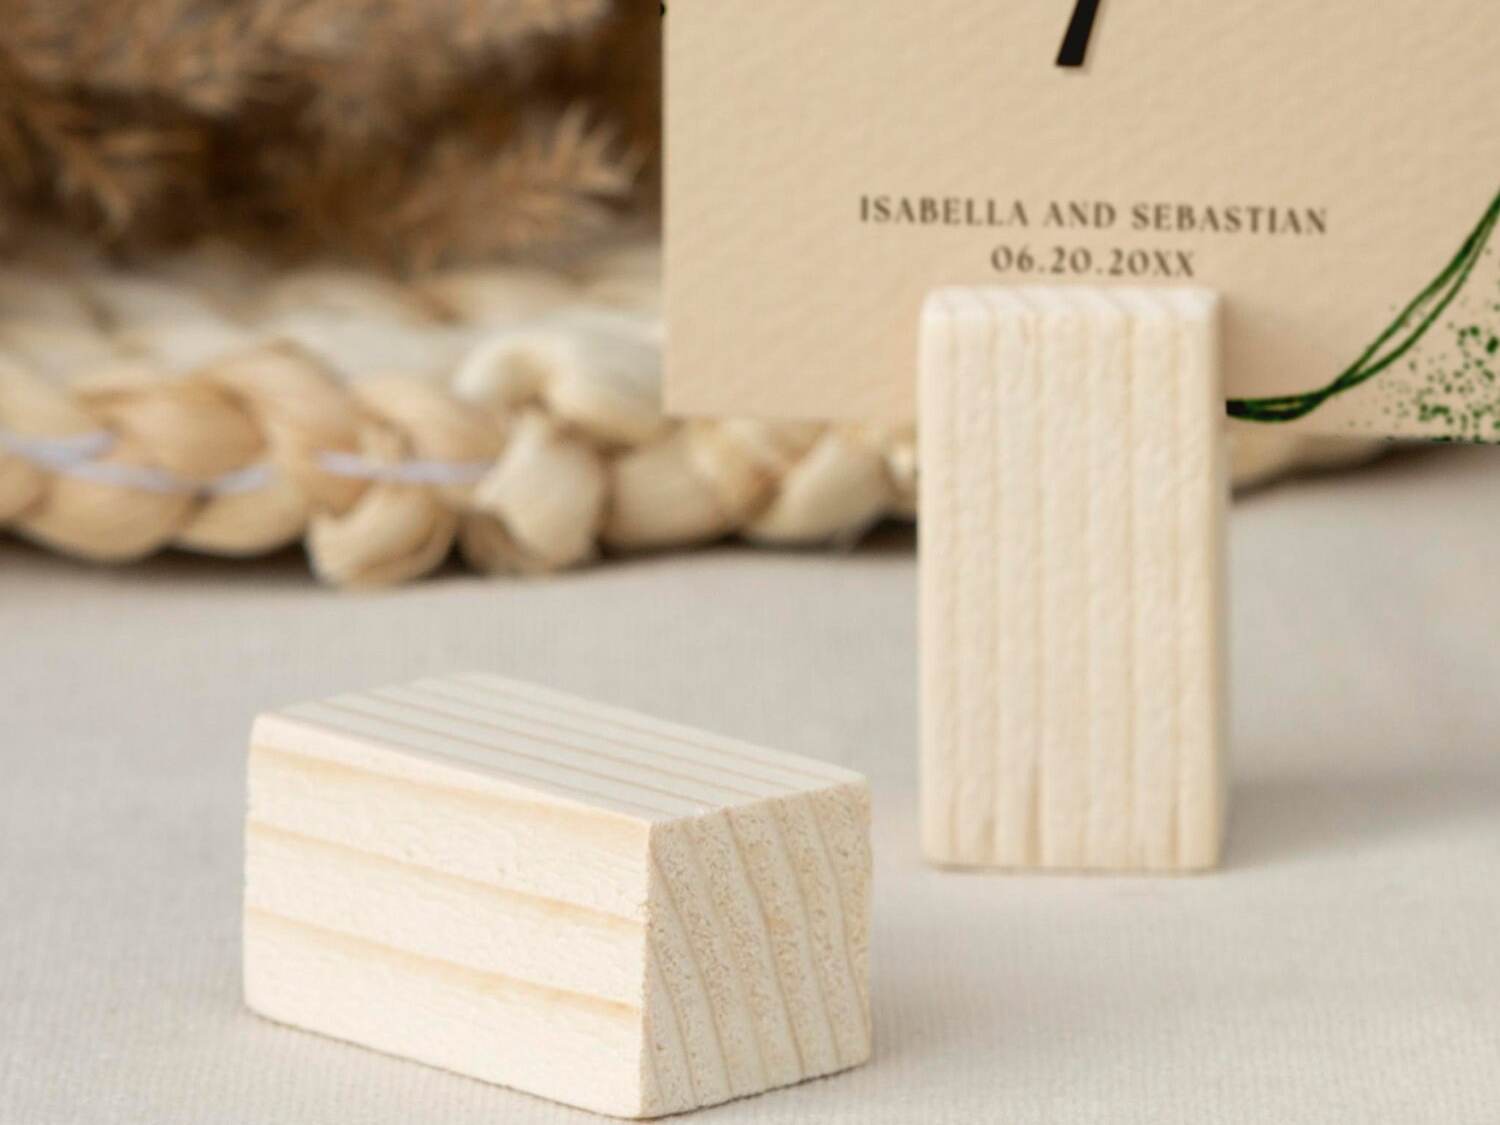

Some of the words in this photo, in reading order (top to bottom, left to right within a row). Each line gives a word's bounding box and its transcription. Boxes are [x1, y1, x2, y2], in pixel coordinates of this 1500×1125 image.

[859, 195, 1029, 227] ISABELLA
[1042, 200, 1117, 230] AND
[1131, 203, 1328, 235] SEBASTIAN
[990, 243, 1195, 278] 06.20.20XX
